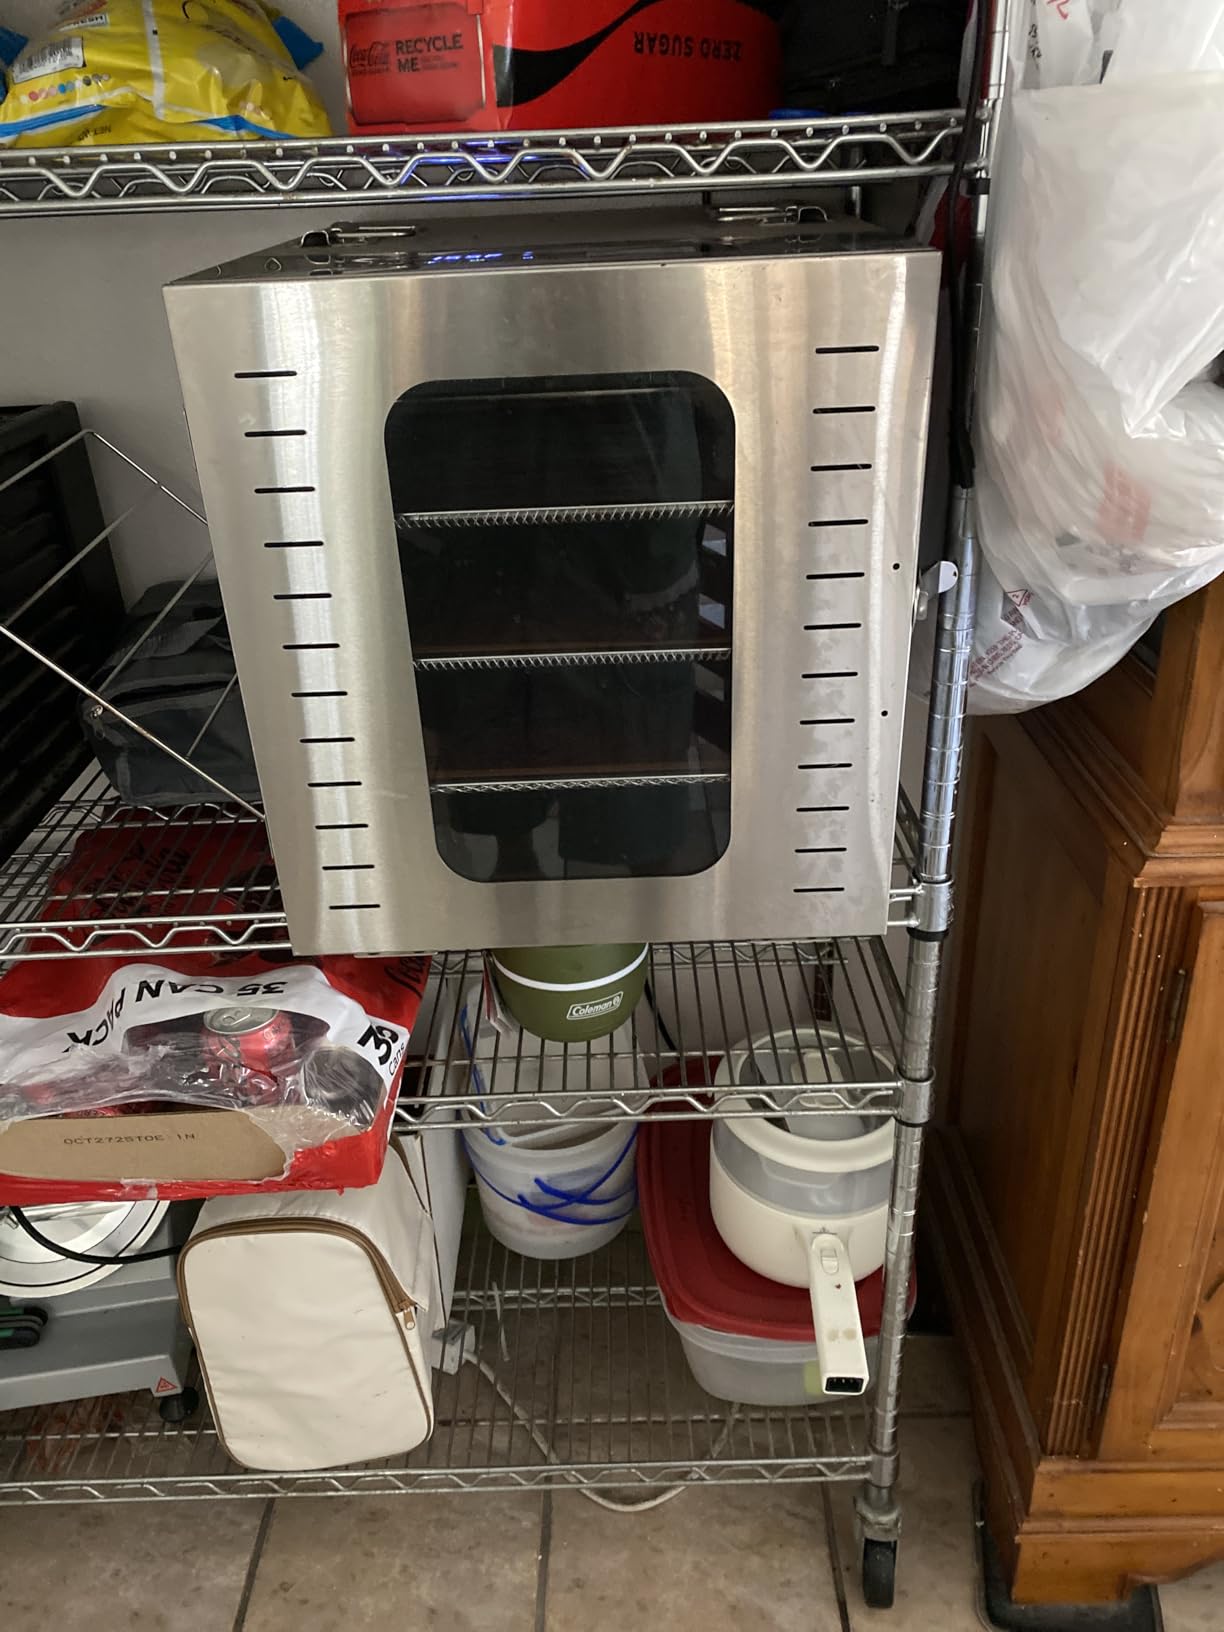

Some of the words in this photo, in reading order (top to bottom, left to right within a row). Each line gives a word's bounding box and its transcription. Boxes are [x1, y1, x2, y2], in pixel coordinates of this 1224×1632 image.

[395, 33, 463, 55] RECYCLE
[634, 31, 694, 57] SUGAR
[701, 38, 742, 61] ZERO
[397, 57, 420, 72] ME
[135, 979, 224, 1003] CAN
[237, 981, 288, 997] 35
[572, 1001, 613, 1016] Coleman
[62, 987, 127, 1053] PACK
